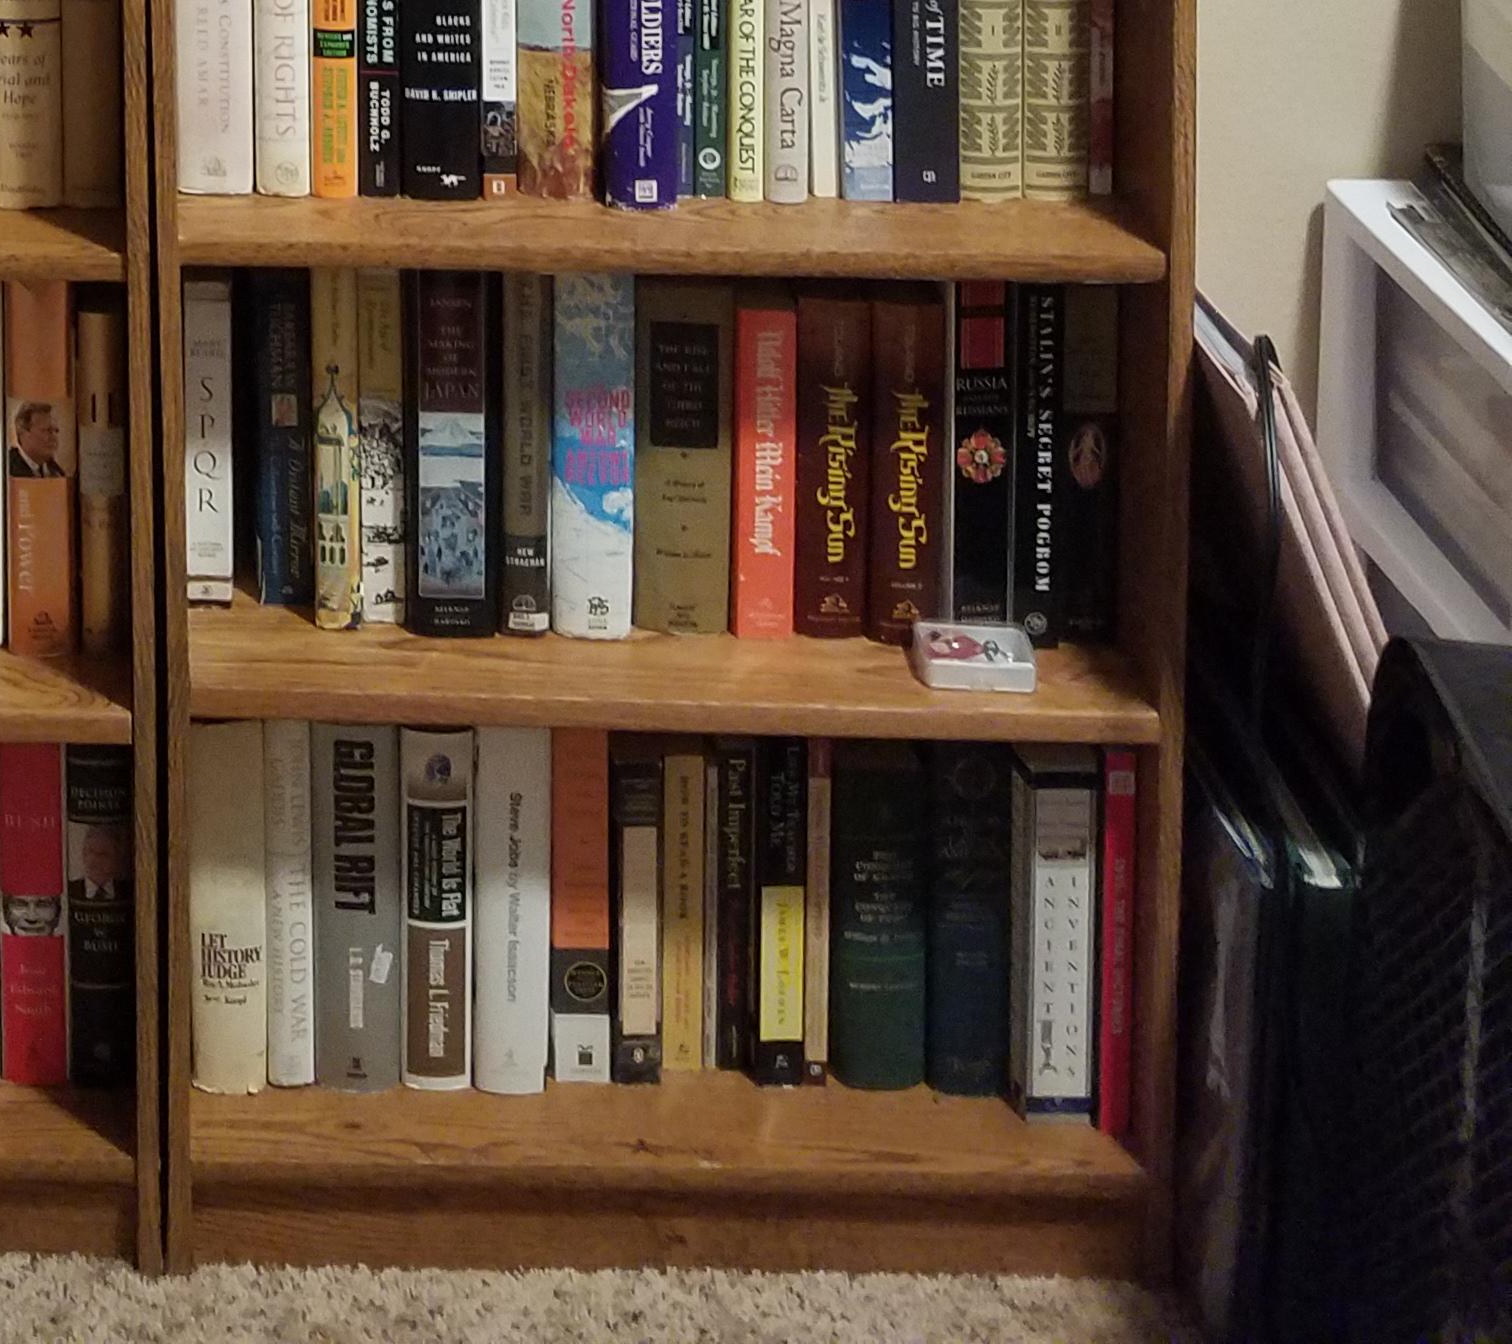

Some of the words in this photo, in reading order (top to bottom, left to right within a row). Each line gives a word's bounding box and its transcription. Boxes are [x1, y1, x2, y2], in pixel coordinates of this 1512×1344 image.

[382, 16, 394, 63] FROM
[768, 0, 803, 79] Magna
[925, 17, 946, 88] TIME
[779, 86, 803, 151] Carta
[1035, 409, 1053, 495] SECRET
[1033, 503, 1052, 592] POGROM
[333, 740, 375, 847] GLOBAL
[334, 854, 376, 914] RIFT
[200, 947, 263, 964] HISTORY
[200, 963, 248, 979] JUDGE
